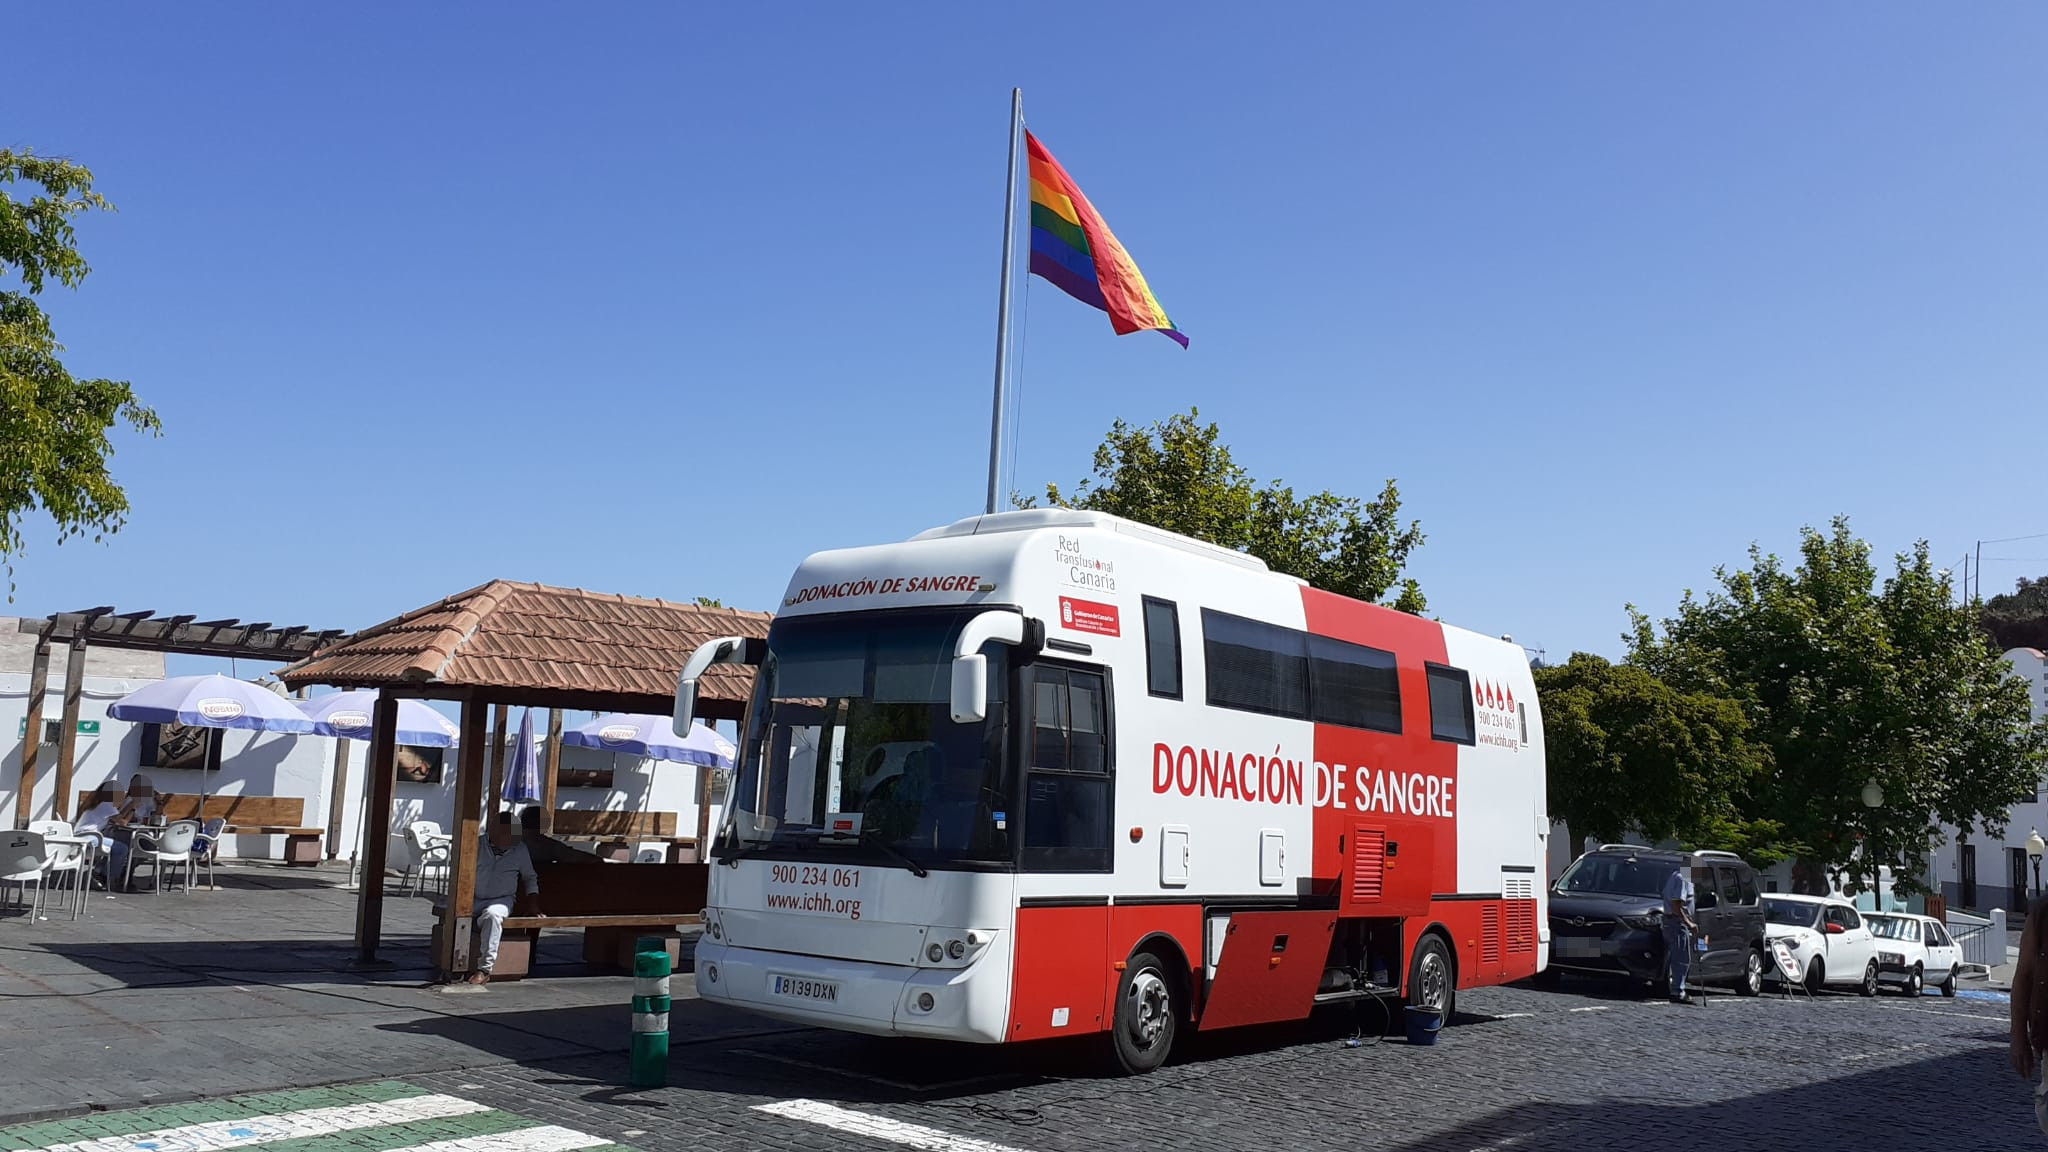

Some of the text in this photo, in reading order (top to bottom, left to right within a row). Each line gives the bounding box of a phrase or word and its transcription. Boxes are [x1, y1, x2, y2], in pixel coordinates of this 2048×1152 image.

[1058, 535, 1080, 553] Red
[796, 575, 981, 603] DONACIÓN DE SANGRE
[1070, 566, 1116, 591] Canaria
[1478, 711, 1516, 730] 900 234 061
[1478, 732, 1519, 753] www.ichh.org
[1152, 743, 1453, 817] DONACIÓN DE SANGRE
[772, 864, 860, 888] 900 234 061
[767, 892, 862, 920] www.ichh.org
[782, 979, 836, 1000] 8139 DXN
